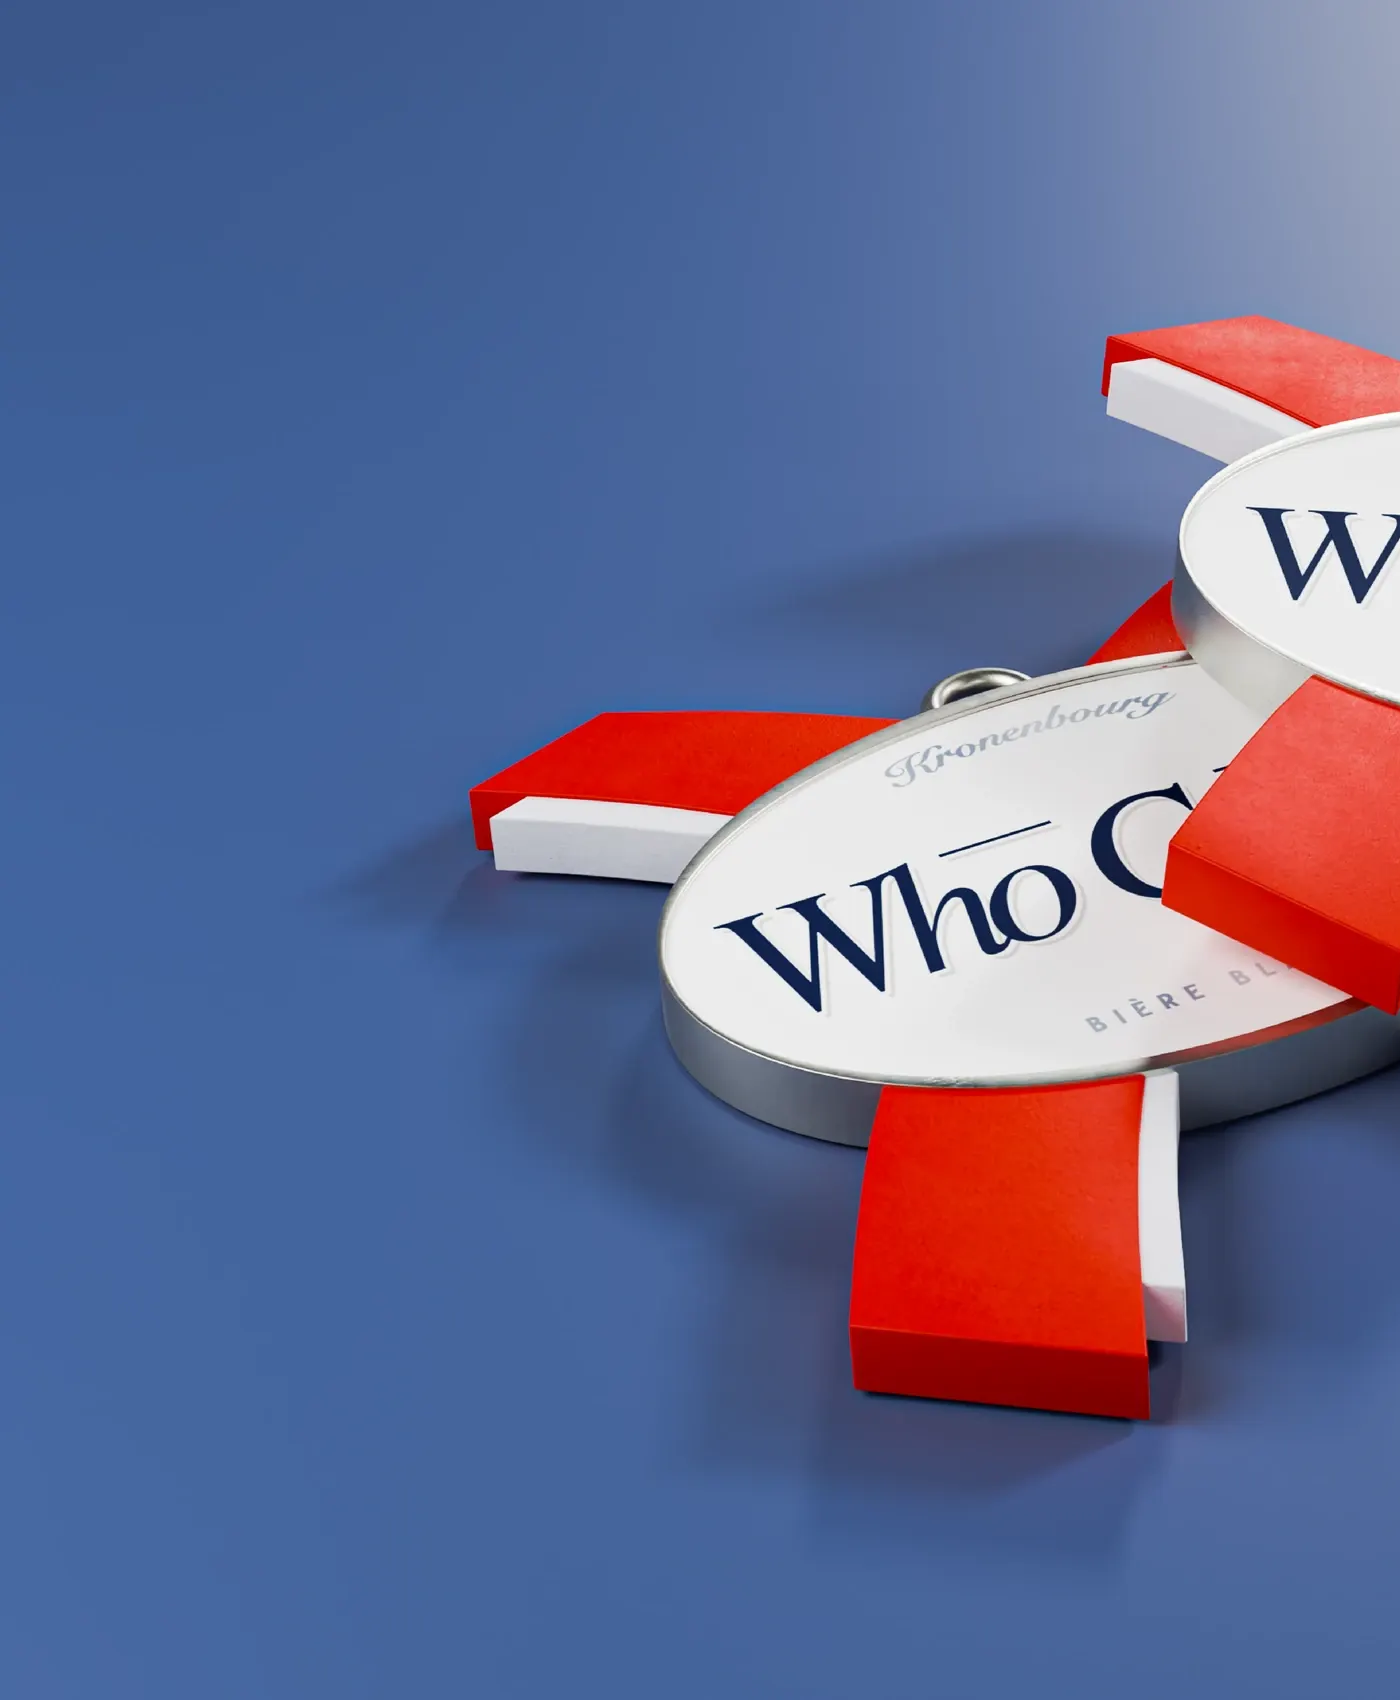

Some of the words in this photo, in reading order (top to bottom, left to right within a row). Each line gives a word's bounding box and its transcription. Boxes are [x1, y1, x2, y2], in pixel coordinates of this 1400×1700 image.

[883, 690, 1178, 788] Kronenbourg
[713, 862, 1078, 1014] Who
[1084, 983, 1207, 1034] BIÈRE
